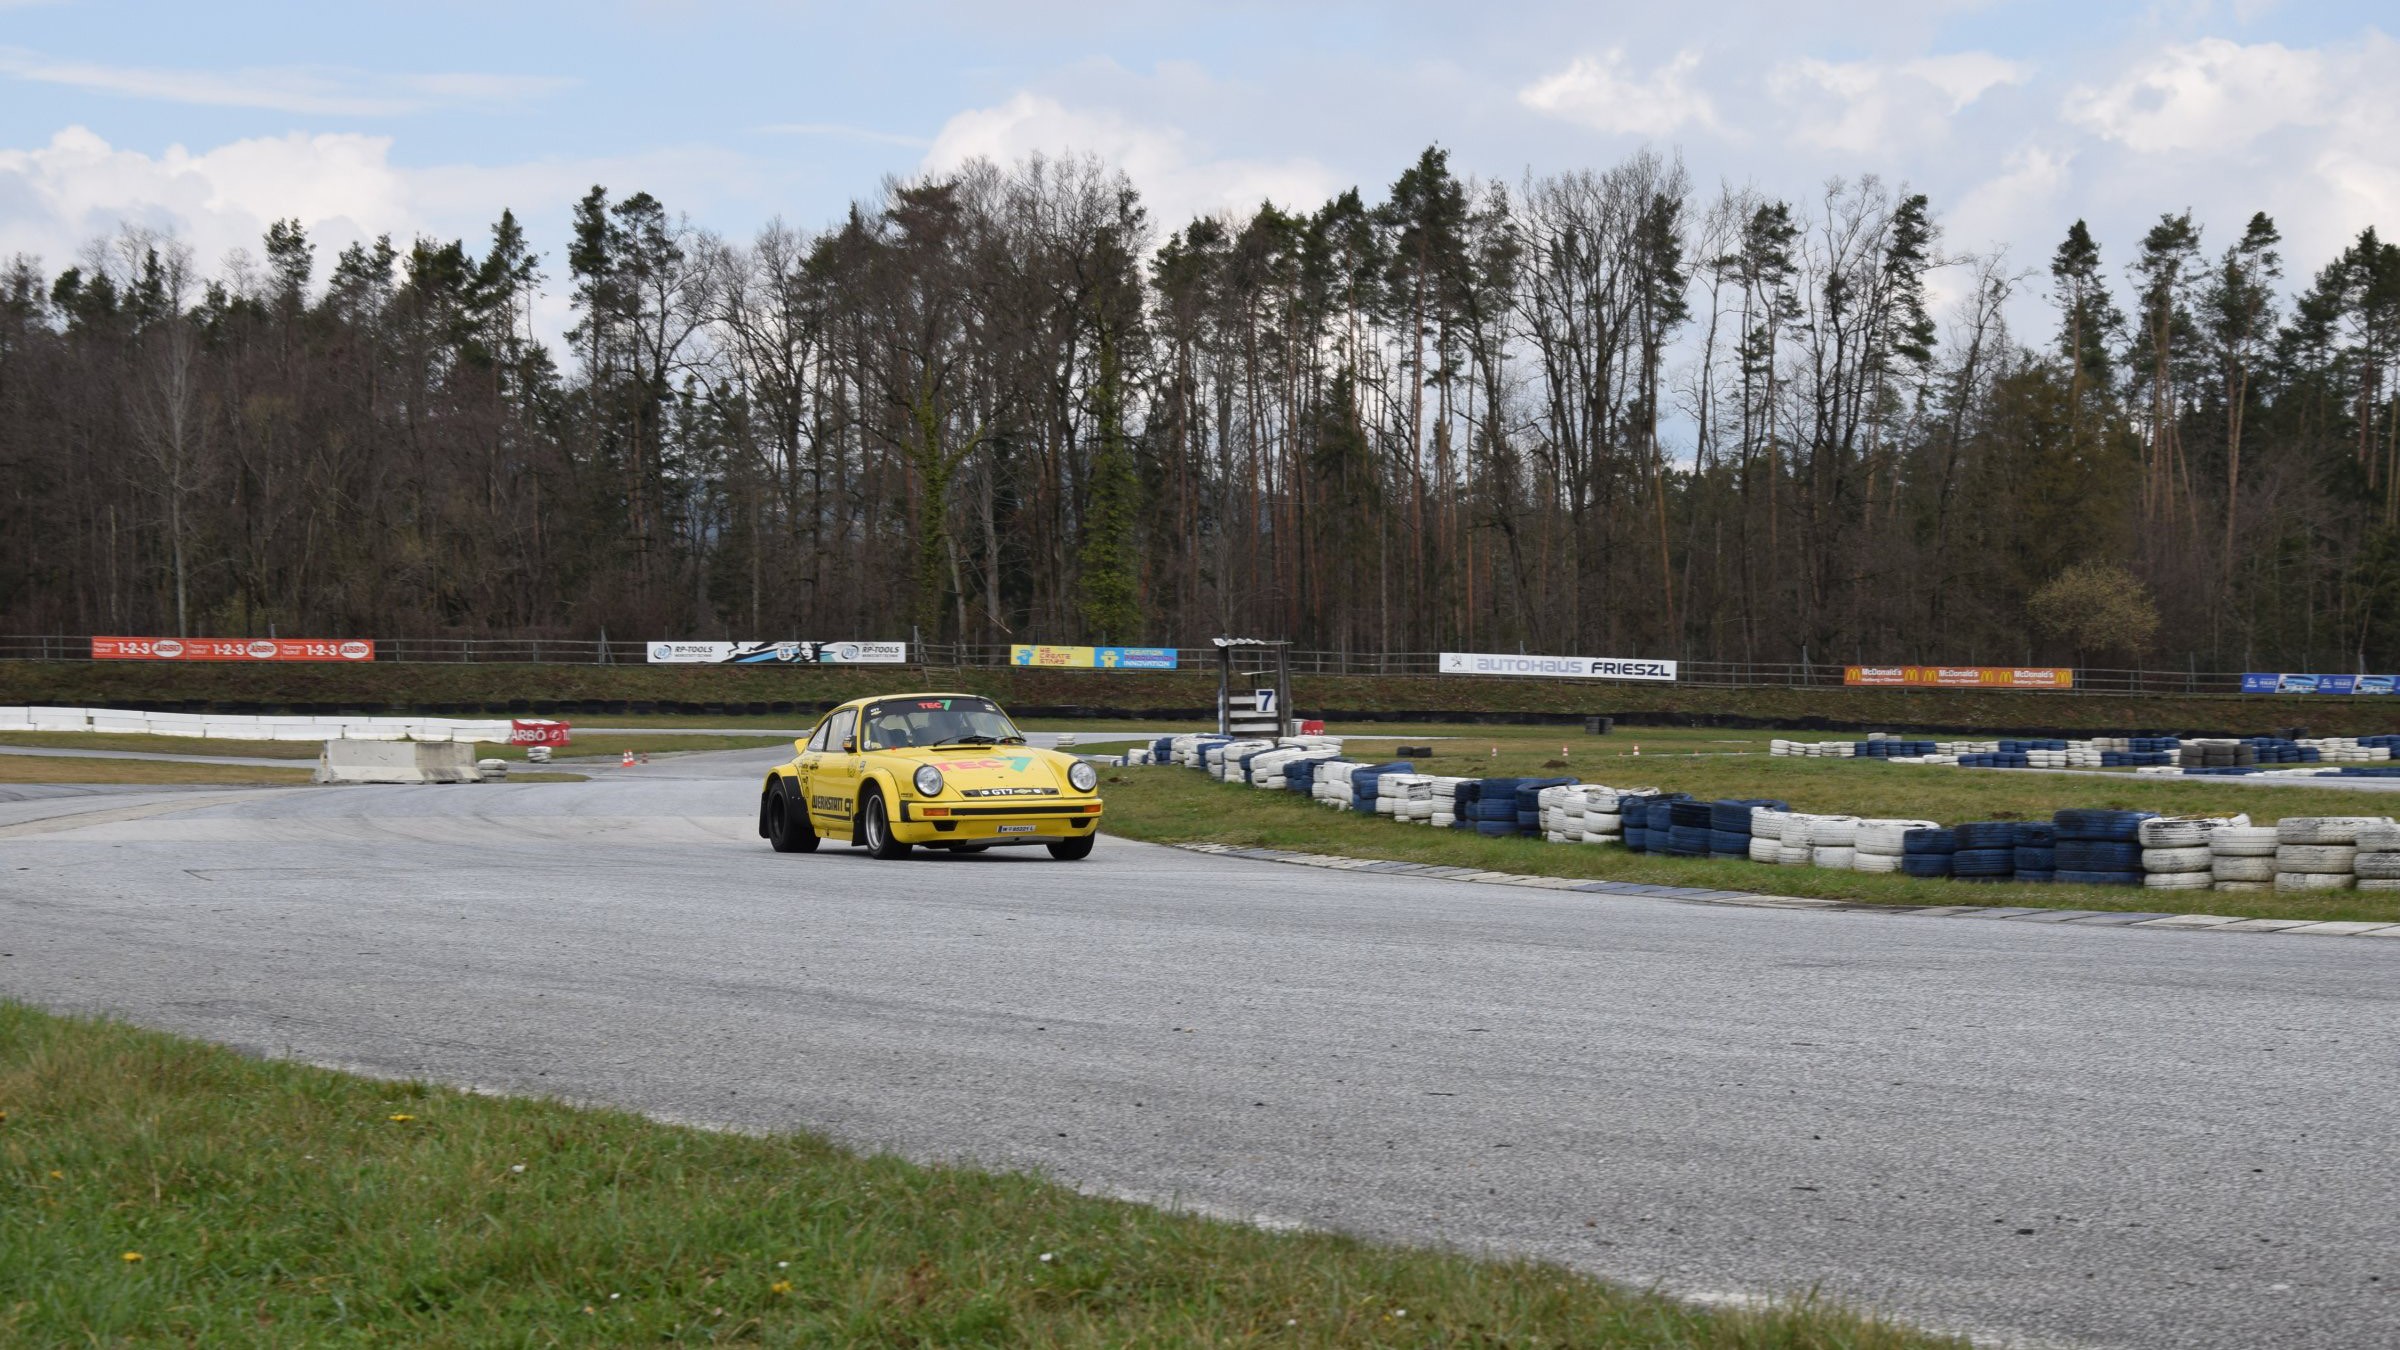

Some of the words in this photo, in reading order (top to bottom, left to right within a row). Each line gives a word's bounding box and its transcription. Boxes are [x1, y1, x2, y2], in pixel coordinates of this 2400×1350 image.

[1591, 662, 1671, 677] FRIESZL
[1258, 691, 1273, 711] 7
[511, 727, 547, 742] ARBÖ
